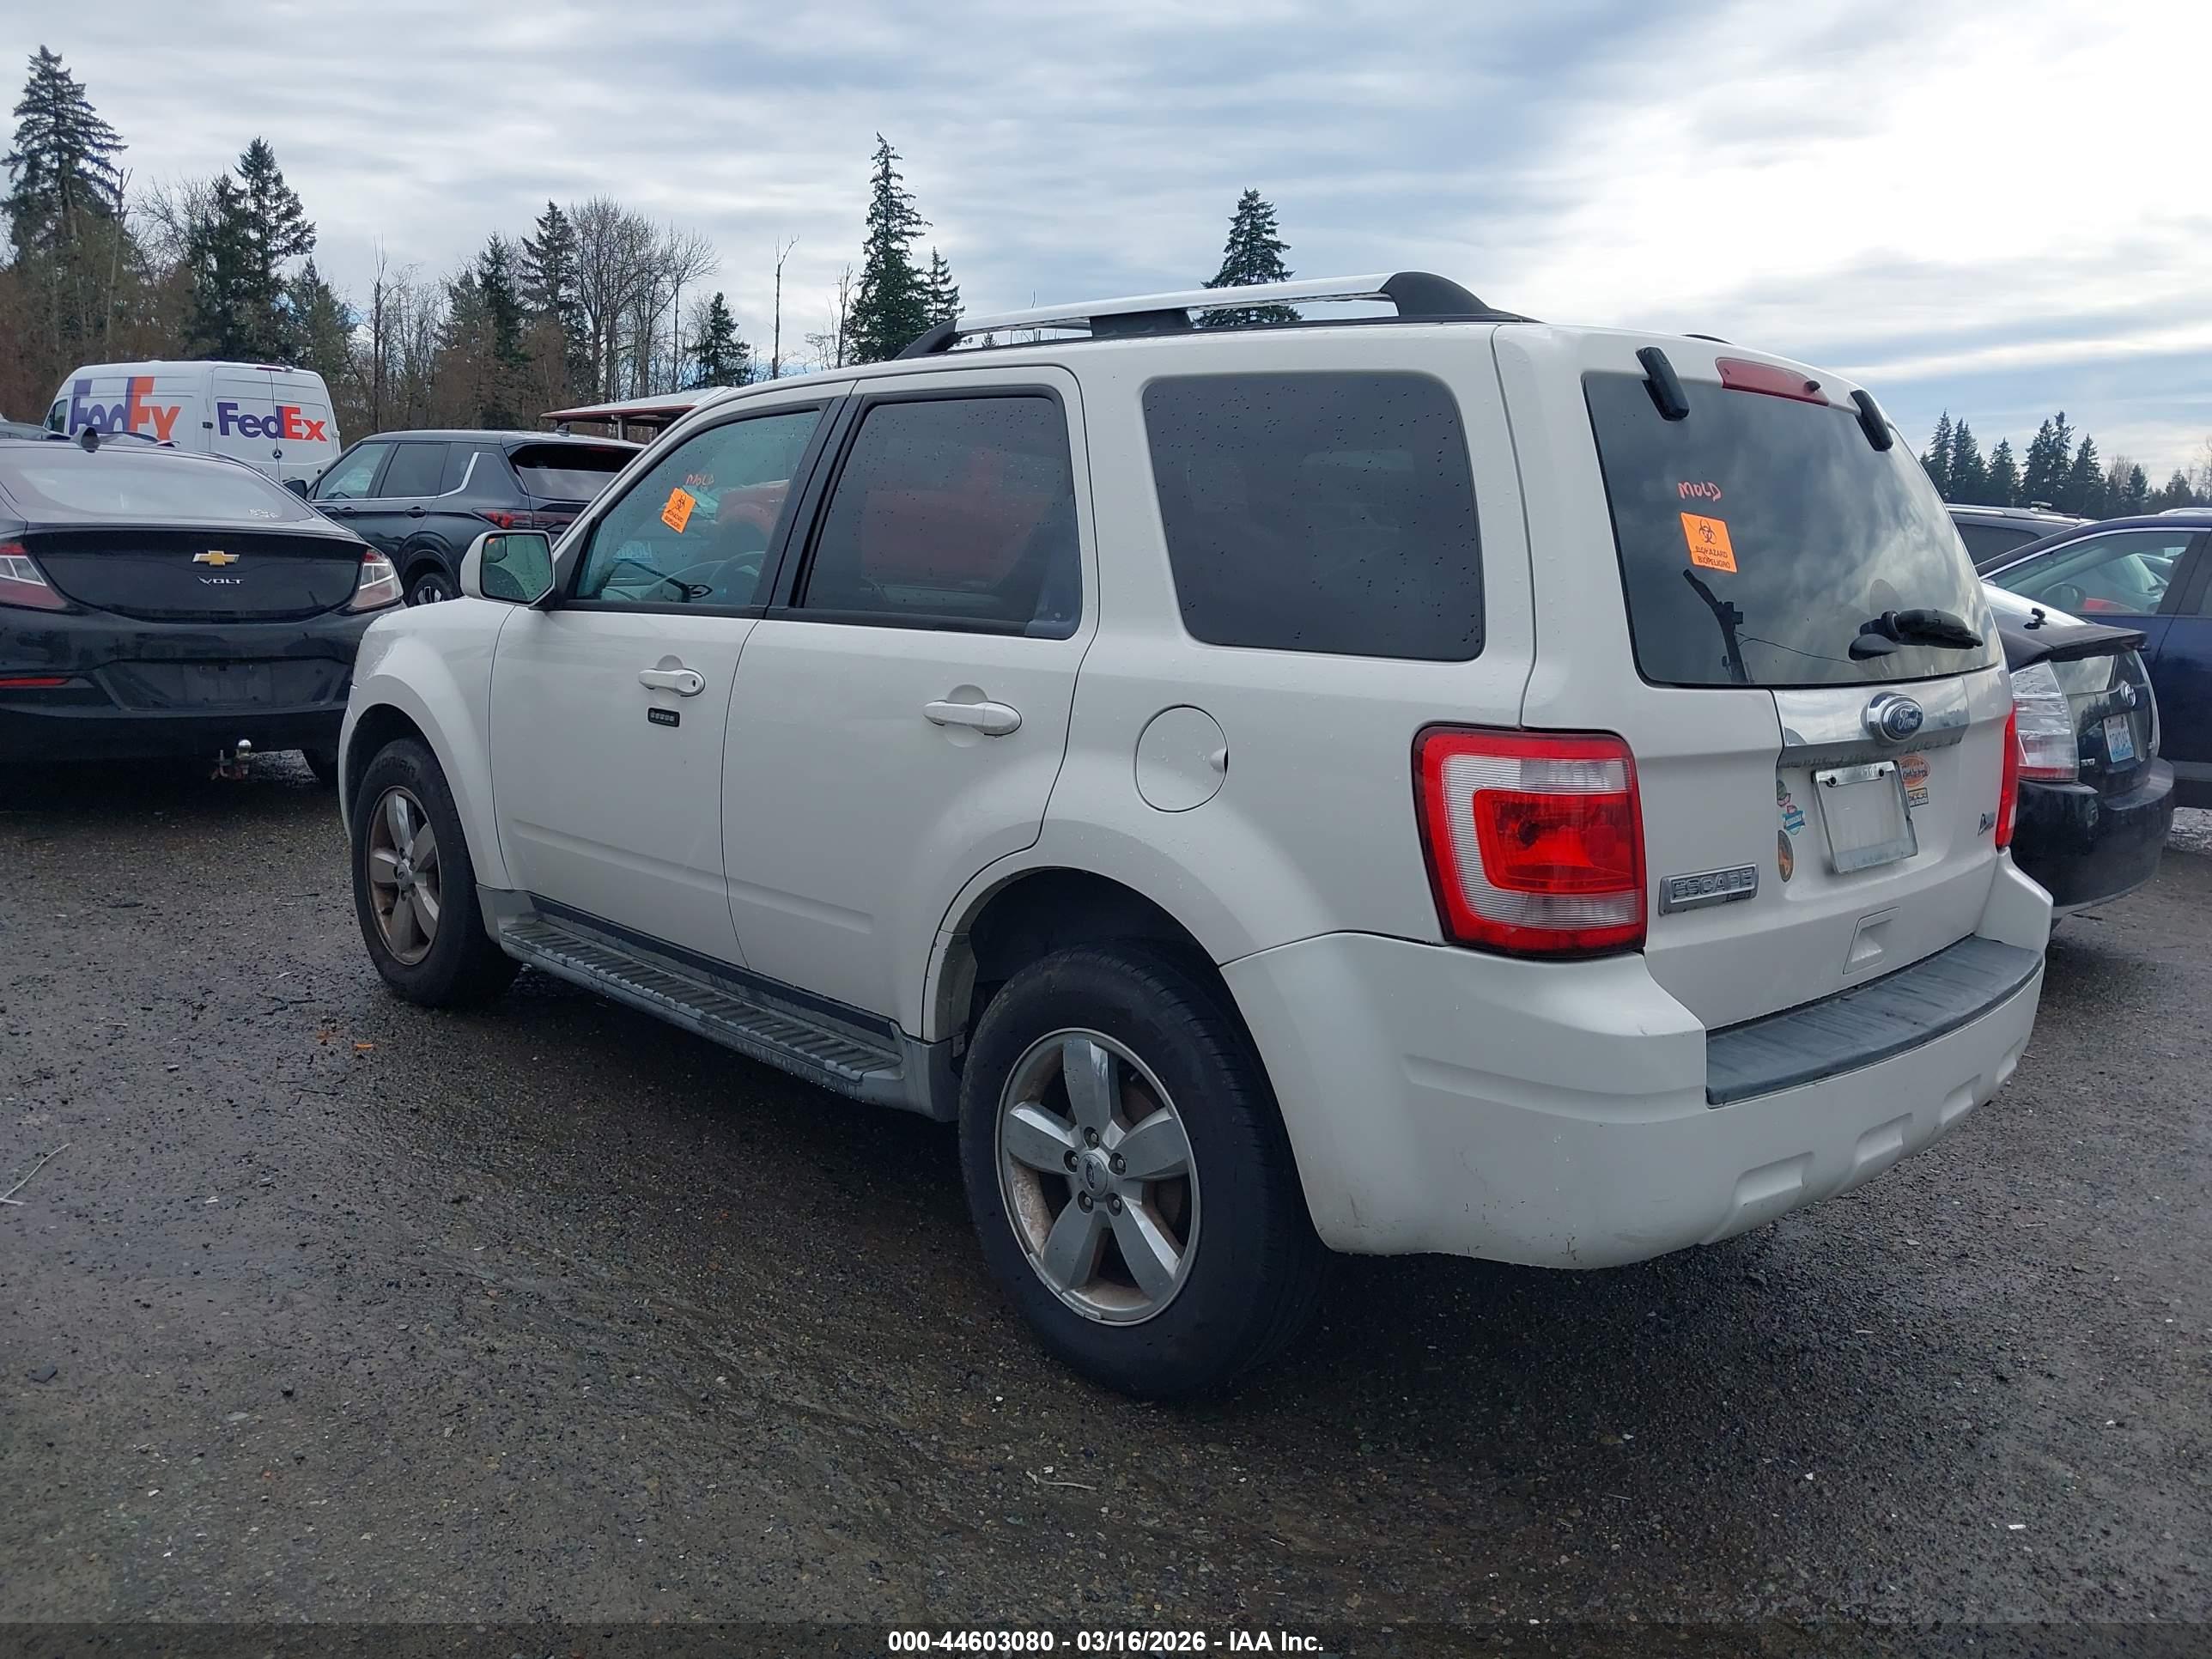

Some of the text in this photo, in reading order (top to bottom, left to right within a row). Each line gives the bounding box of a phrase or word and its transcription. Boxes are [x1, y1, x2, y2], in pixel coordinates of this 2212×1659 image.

[216, 402, 327, 441] FedEx
[1678, 481, 1722, 501] MOLD
[197, 575, 245, 587] VOLT
[1898, 708, 1918, 730] Ford
[1673, 868, 1753, 900] ESCAPE
